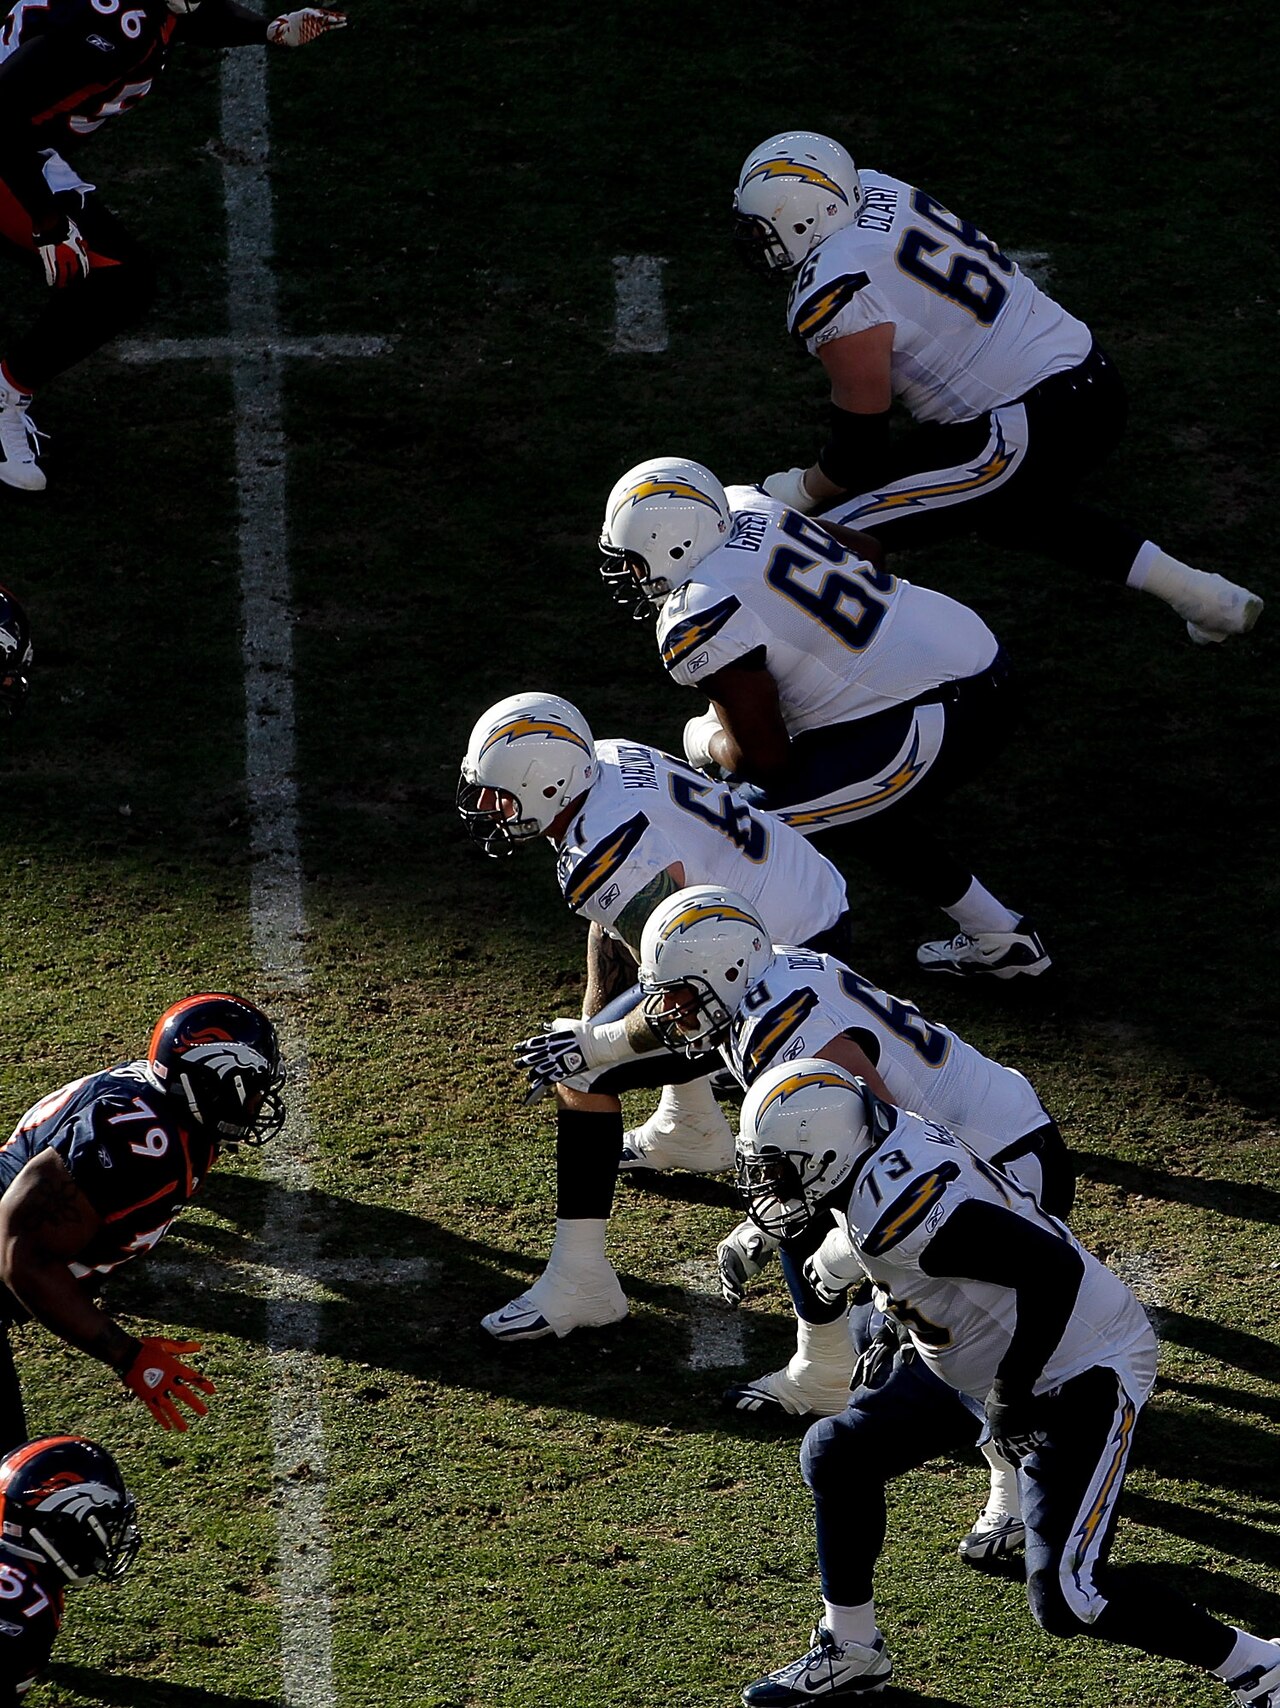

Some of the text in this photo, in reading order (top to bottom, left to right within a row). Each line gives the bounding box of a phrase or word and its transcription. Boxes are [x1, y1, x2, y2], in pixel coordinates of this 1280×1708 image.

[836, 967, 953, 1069] 6
[108, 1096, 169, 1158] 79
[858, 1148, 915, 1208] 73
